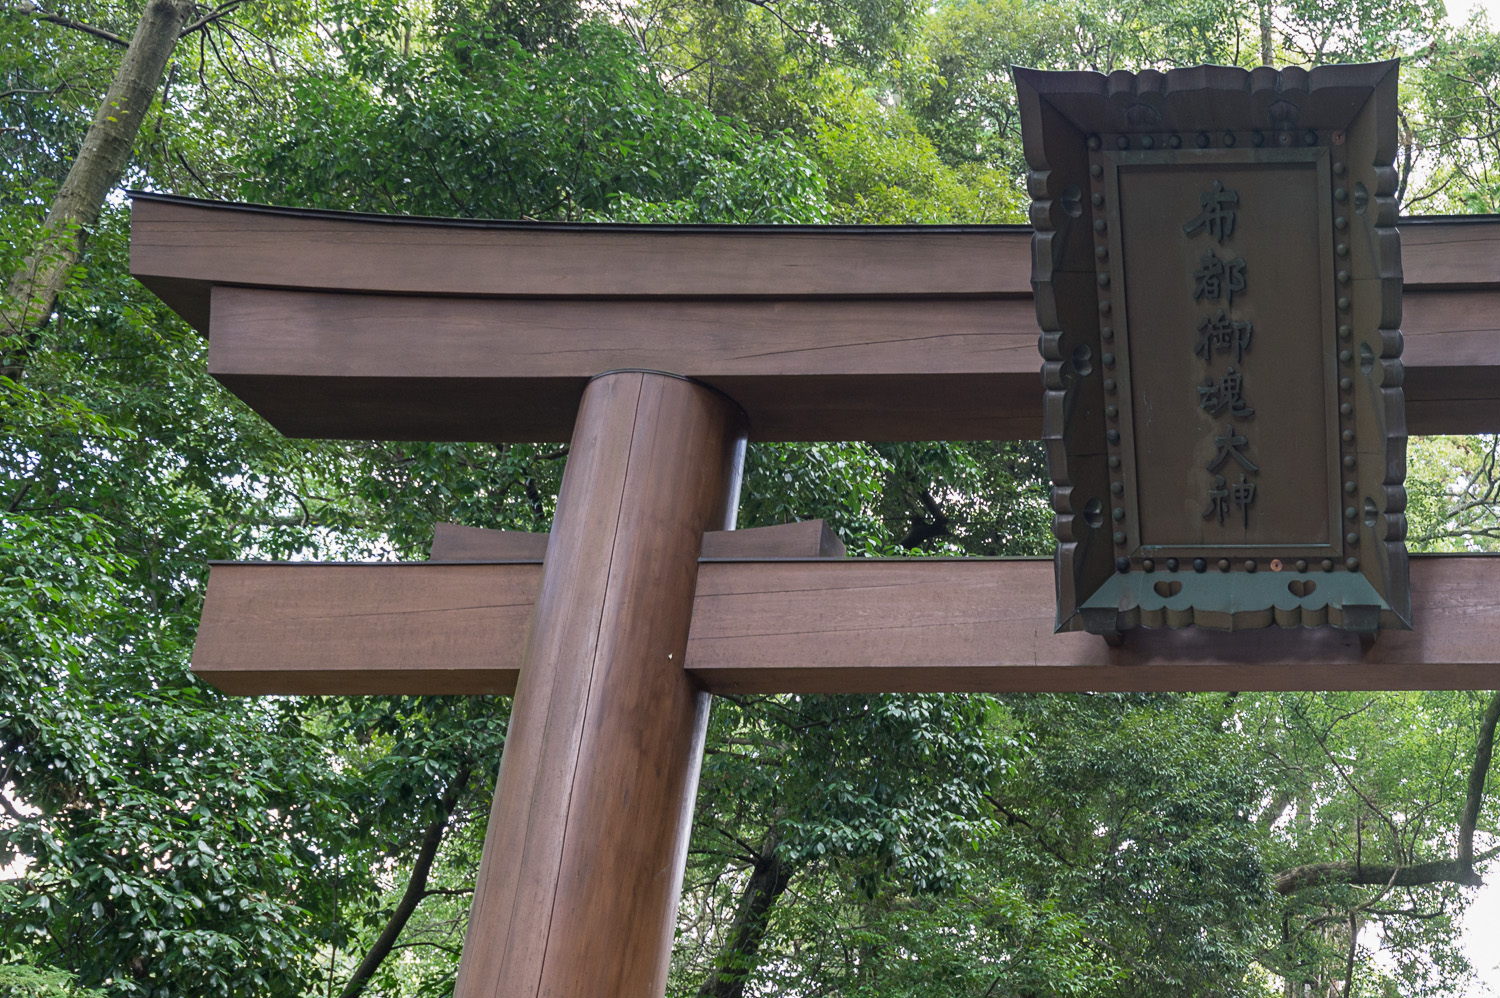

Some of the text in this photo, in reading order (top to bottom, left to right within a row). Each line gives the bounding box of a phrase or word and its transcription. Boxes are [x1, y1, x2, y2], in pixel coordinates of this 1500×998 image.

[1183, 179, 1260, 528] 布都御魂大神
